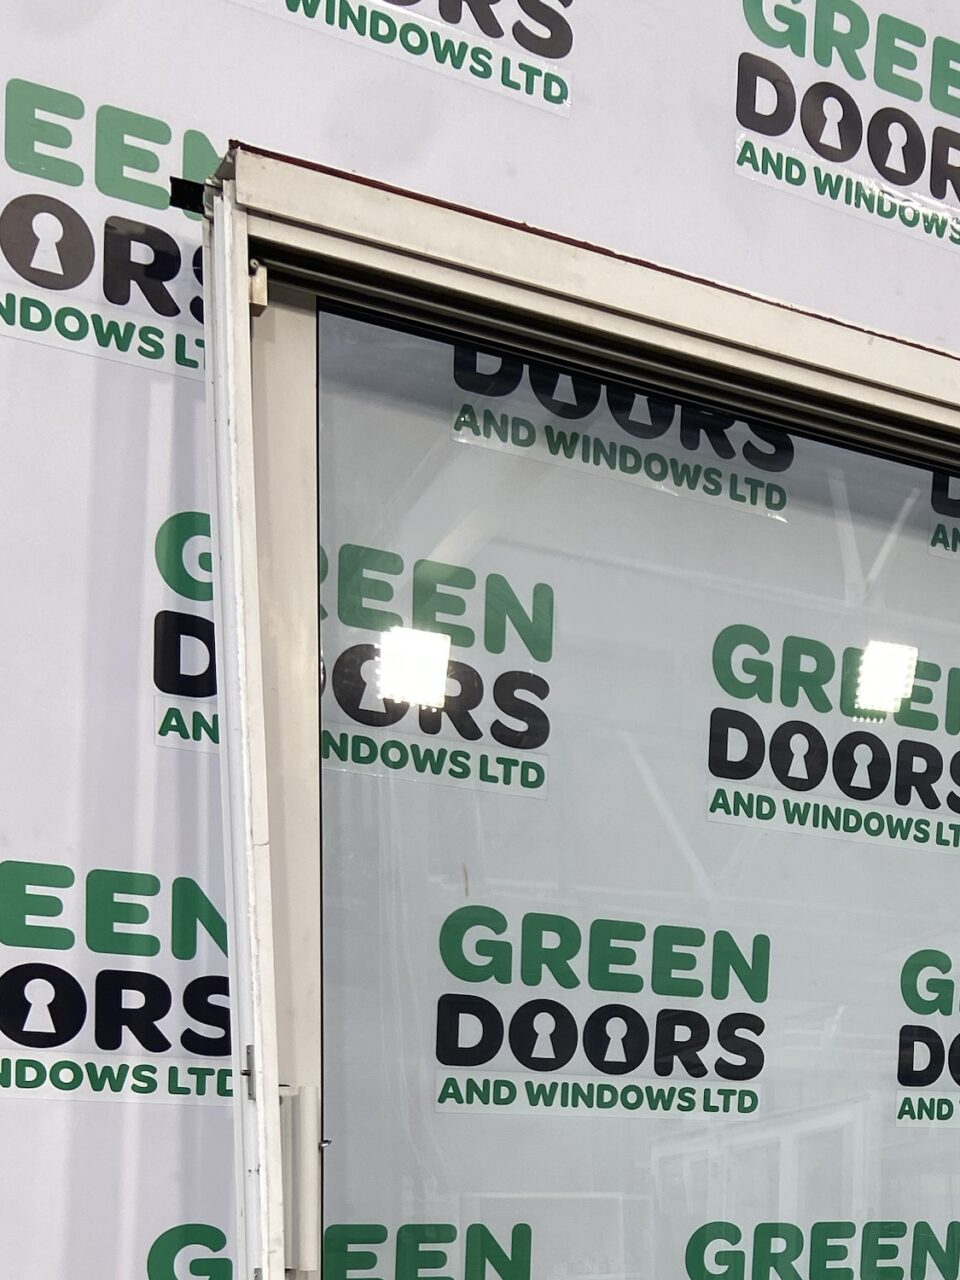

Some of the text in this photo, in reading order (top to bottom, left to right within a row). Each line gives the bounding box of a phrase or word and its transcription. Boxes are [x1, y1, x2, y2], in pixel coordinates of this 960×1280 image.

[501, 57, 569, 105] LTD
[736, 141, 806, 187] AND
[454, 403, 787, 512] AND WINDOWS LTD
[479, 755, 545, 789] LTD
[709, 788, 777, 821] AND
[783, 798, 931, 845] WINDOWS
[439, 905, 770, 1003] GREEN
[435, 993, 765, 1081] DOORS
[437, 1077, 759, 1113] AND WINDOWS LTD
[897, 1097, 954, 1120] AND
